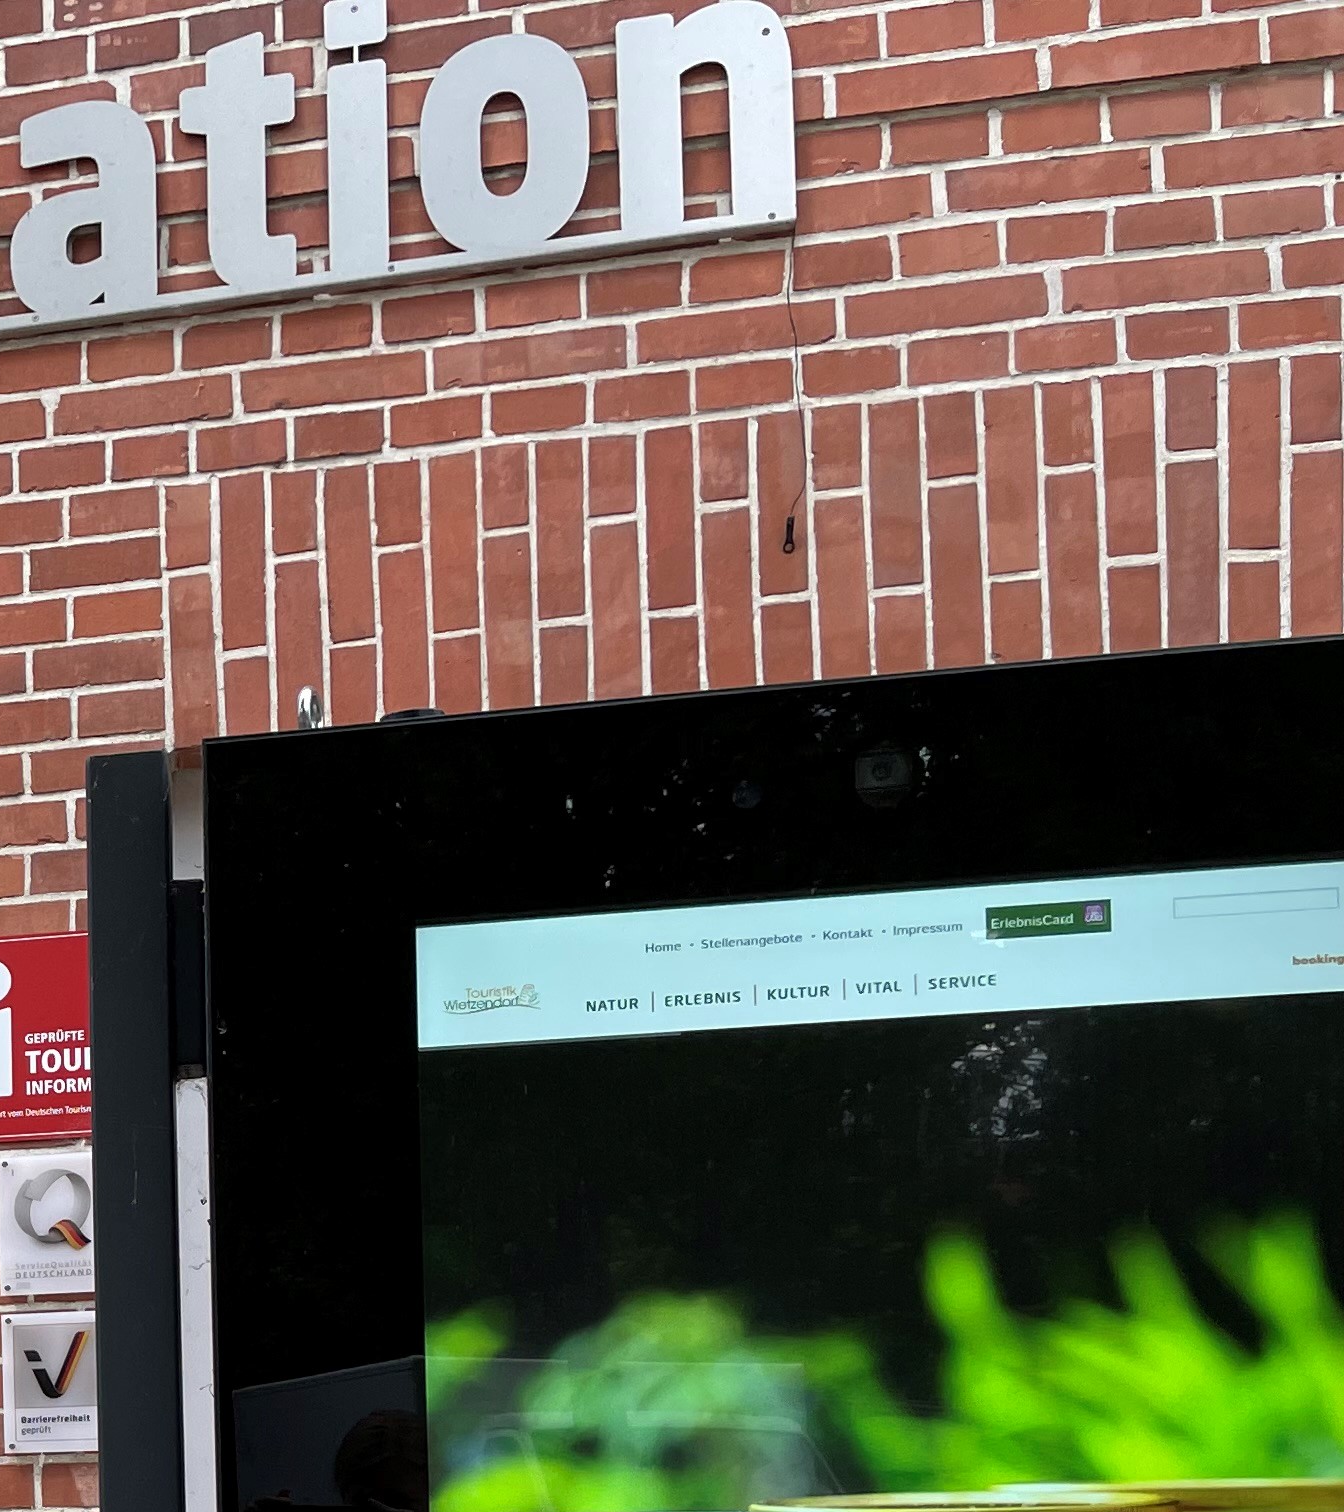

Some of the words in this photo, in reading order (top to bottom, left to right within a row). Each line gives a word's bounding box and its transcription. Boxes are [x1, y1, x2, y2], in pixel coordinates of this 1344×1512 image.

[991, 913, 1074, 929] ErlebnisCard
[645, 940, 681, 954] Home
[701, 933, 802, 951] Stellenangebote
[822, 927, 873, 941] Kontakt
[893, 921, 963, 938] Impressum
[465, 985, 517, 999] Touristik
[586, 998, 639, 1012] NATUR
[665, 990, 742, 1007] ERLEBNIS
[767, 984, 830, 1001] KULTUR
[856, 980, 902, 995] VITAL
[928, 973, 998, 991] SERVICE
[444, 996, 520, 1012] Wietzendorf
[25, 1029, 85, 1044] GEPRÜFTE
[8, 1110, 23, 1118] vom
[25, 1107, 63, 1117] Deutschen
[15, 1268, 92, 1279] DEUTSCHLAND
[21, 1413, 91, 1424] Barrierefreiheit
[21, 1426, 52, 1436] geprüft
